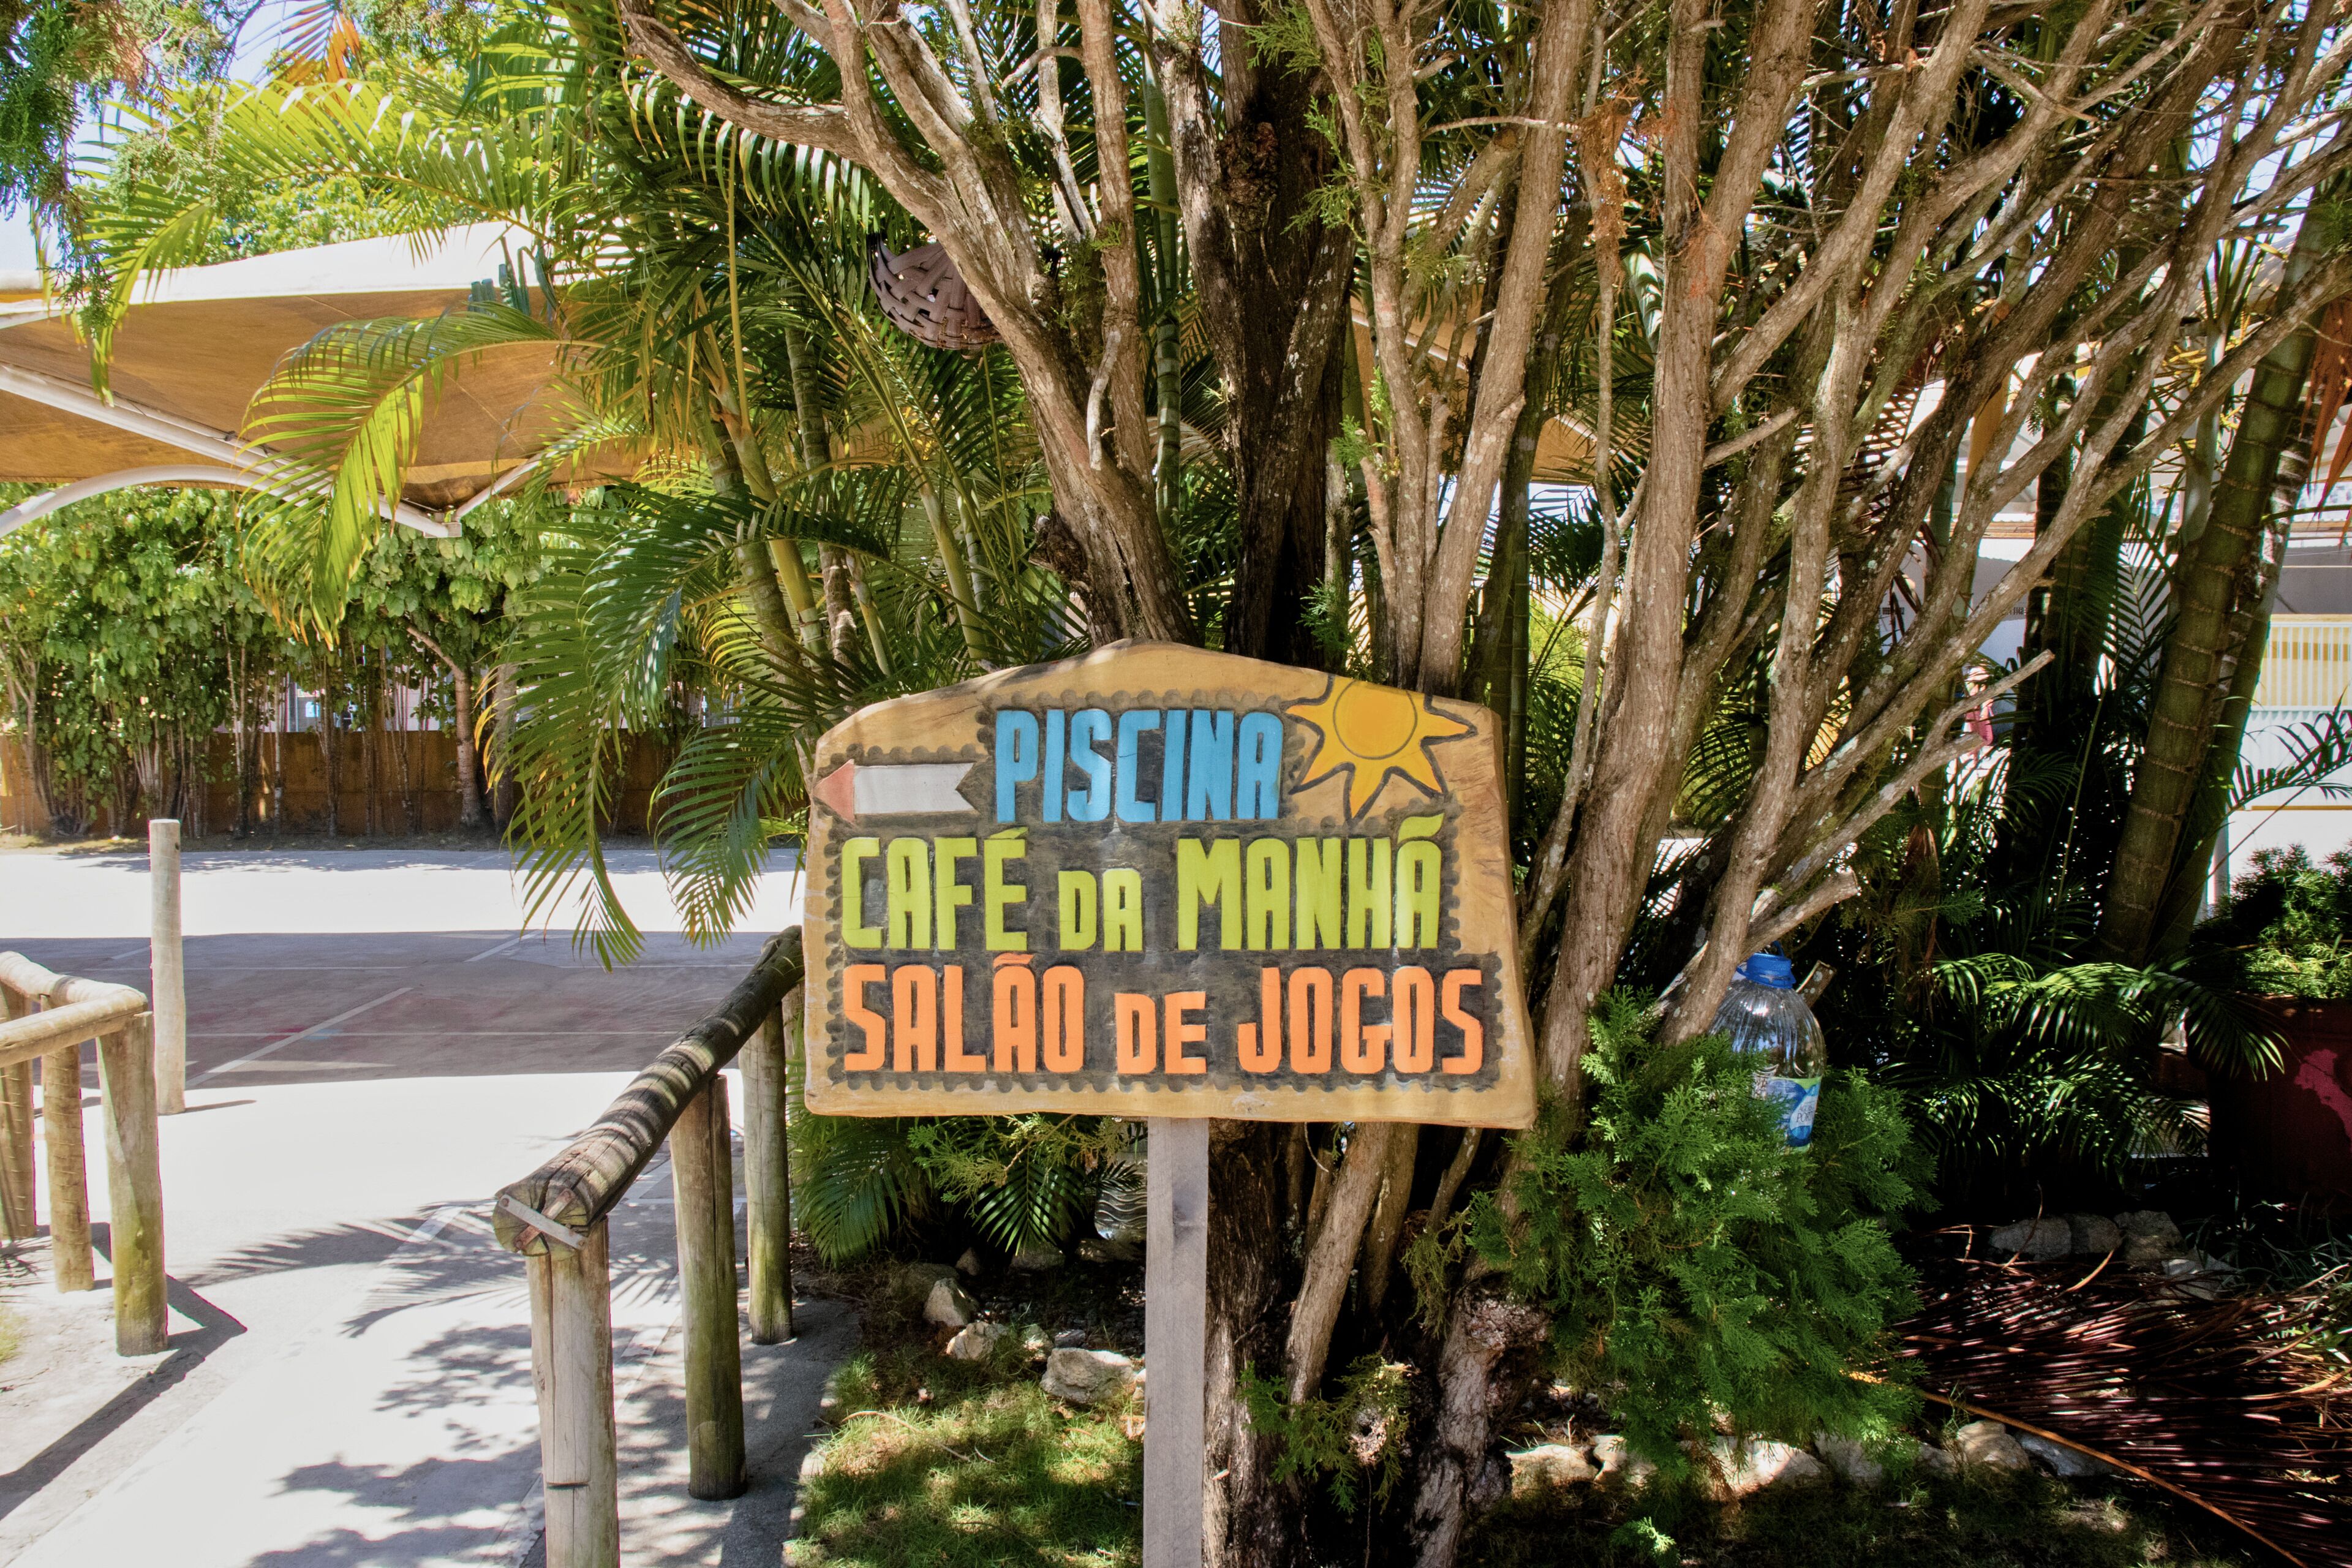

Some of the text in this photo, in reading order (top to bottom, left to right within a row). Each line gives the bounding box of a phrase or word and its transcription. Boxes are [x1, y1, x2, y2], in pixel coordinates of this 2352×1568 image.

[995, 709, 1283, 823] PISCINA
[841, 813, 1445, 952] CAFÉ DA MANHÃ
[843, 952, 1483, 1076] SALÃO DE JOGOS
